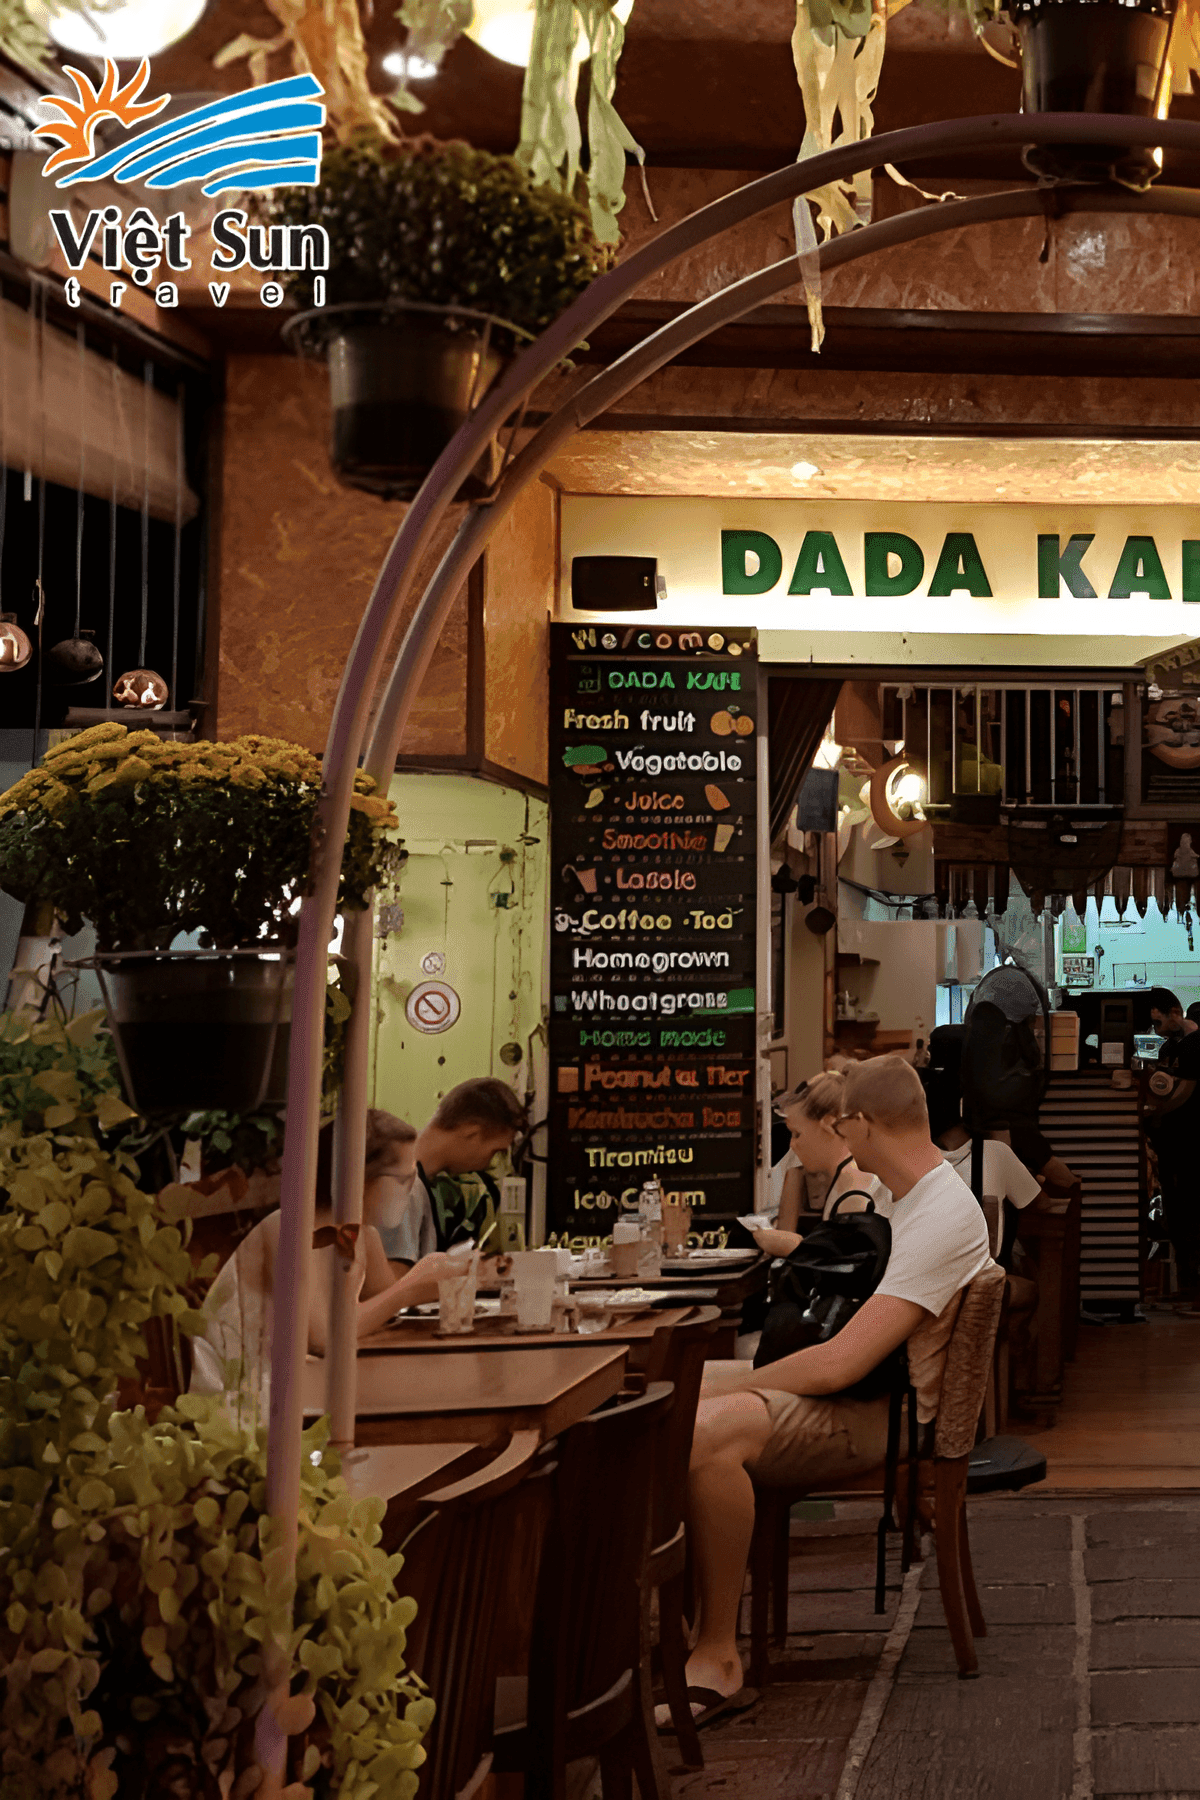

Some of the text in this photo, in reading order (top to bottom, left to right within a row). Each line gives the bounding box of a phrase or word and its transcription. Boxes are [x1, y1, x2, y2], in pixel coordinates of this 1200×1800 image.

[720, 529, 994, 597] DADA
[608, 671, 676, 691] DADA
[640, 709, 696, 732] fruit
[572, 947, 730, 973] Homegrown
[620, 1187, 706, 1210] Cam
